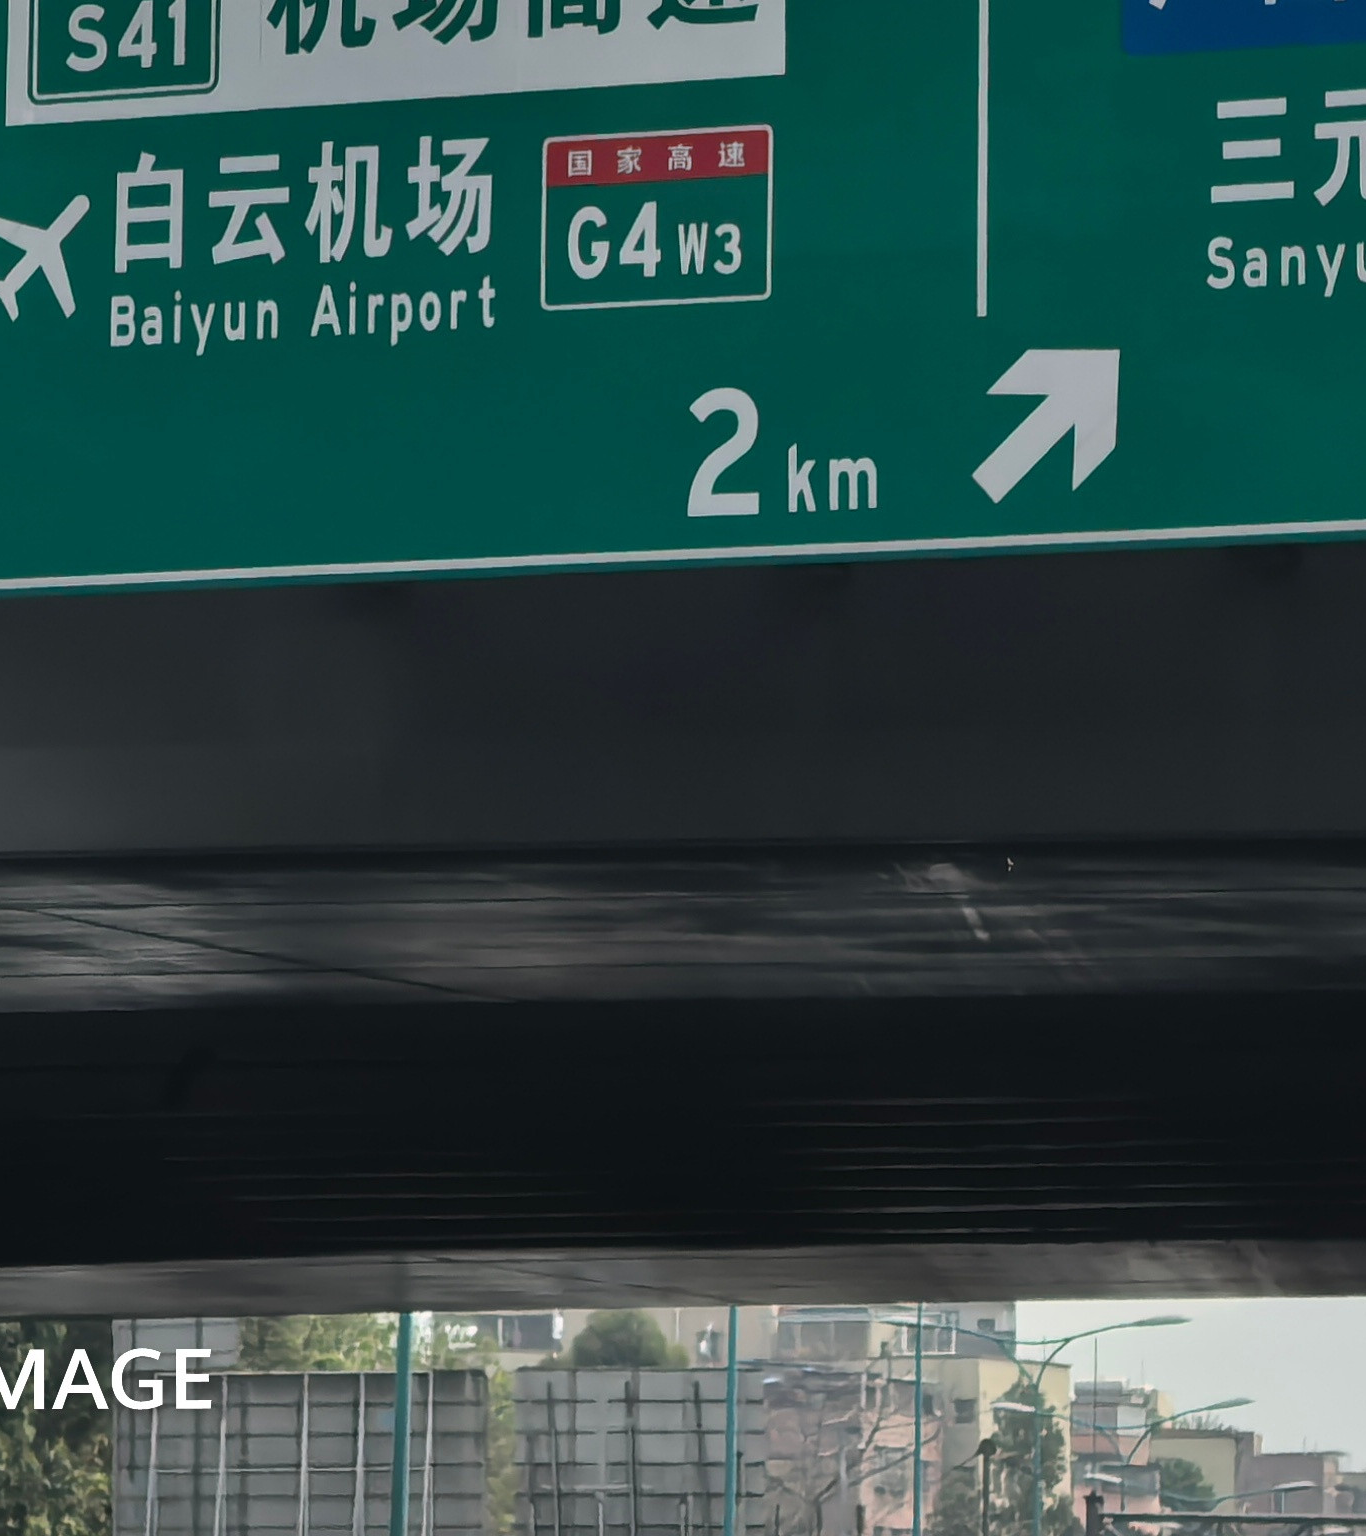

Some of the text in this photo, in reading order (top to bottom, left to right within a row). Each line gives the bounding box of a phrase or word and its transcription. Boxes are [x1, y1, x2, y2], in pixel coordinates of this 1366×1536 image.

[114, 136, 493, 274] 白云机场
[567, 141, 746, 178] 国家高速
[110, 275, 496, 357] Baiyun Airport
[687, 387, 879, 517] 2 km
